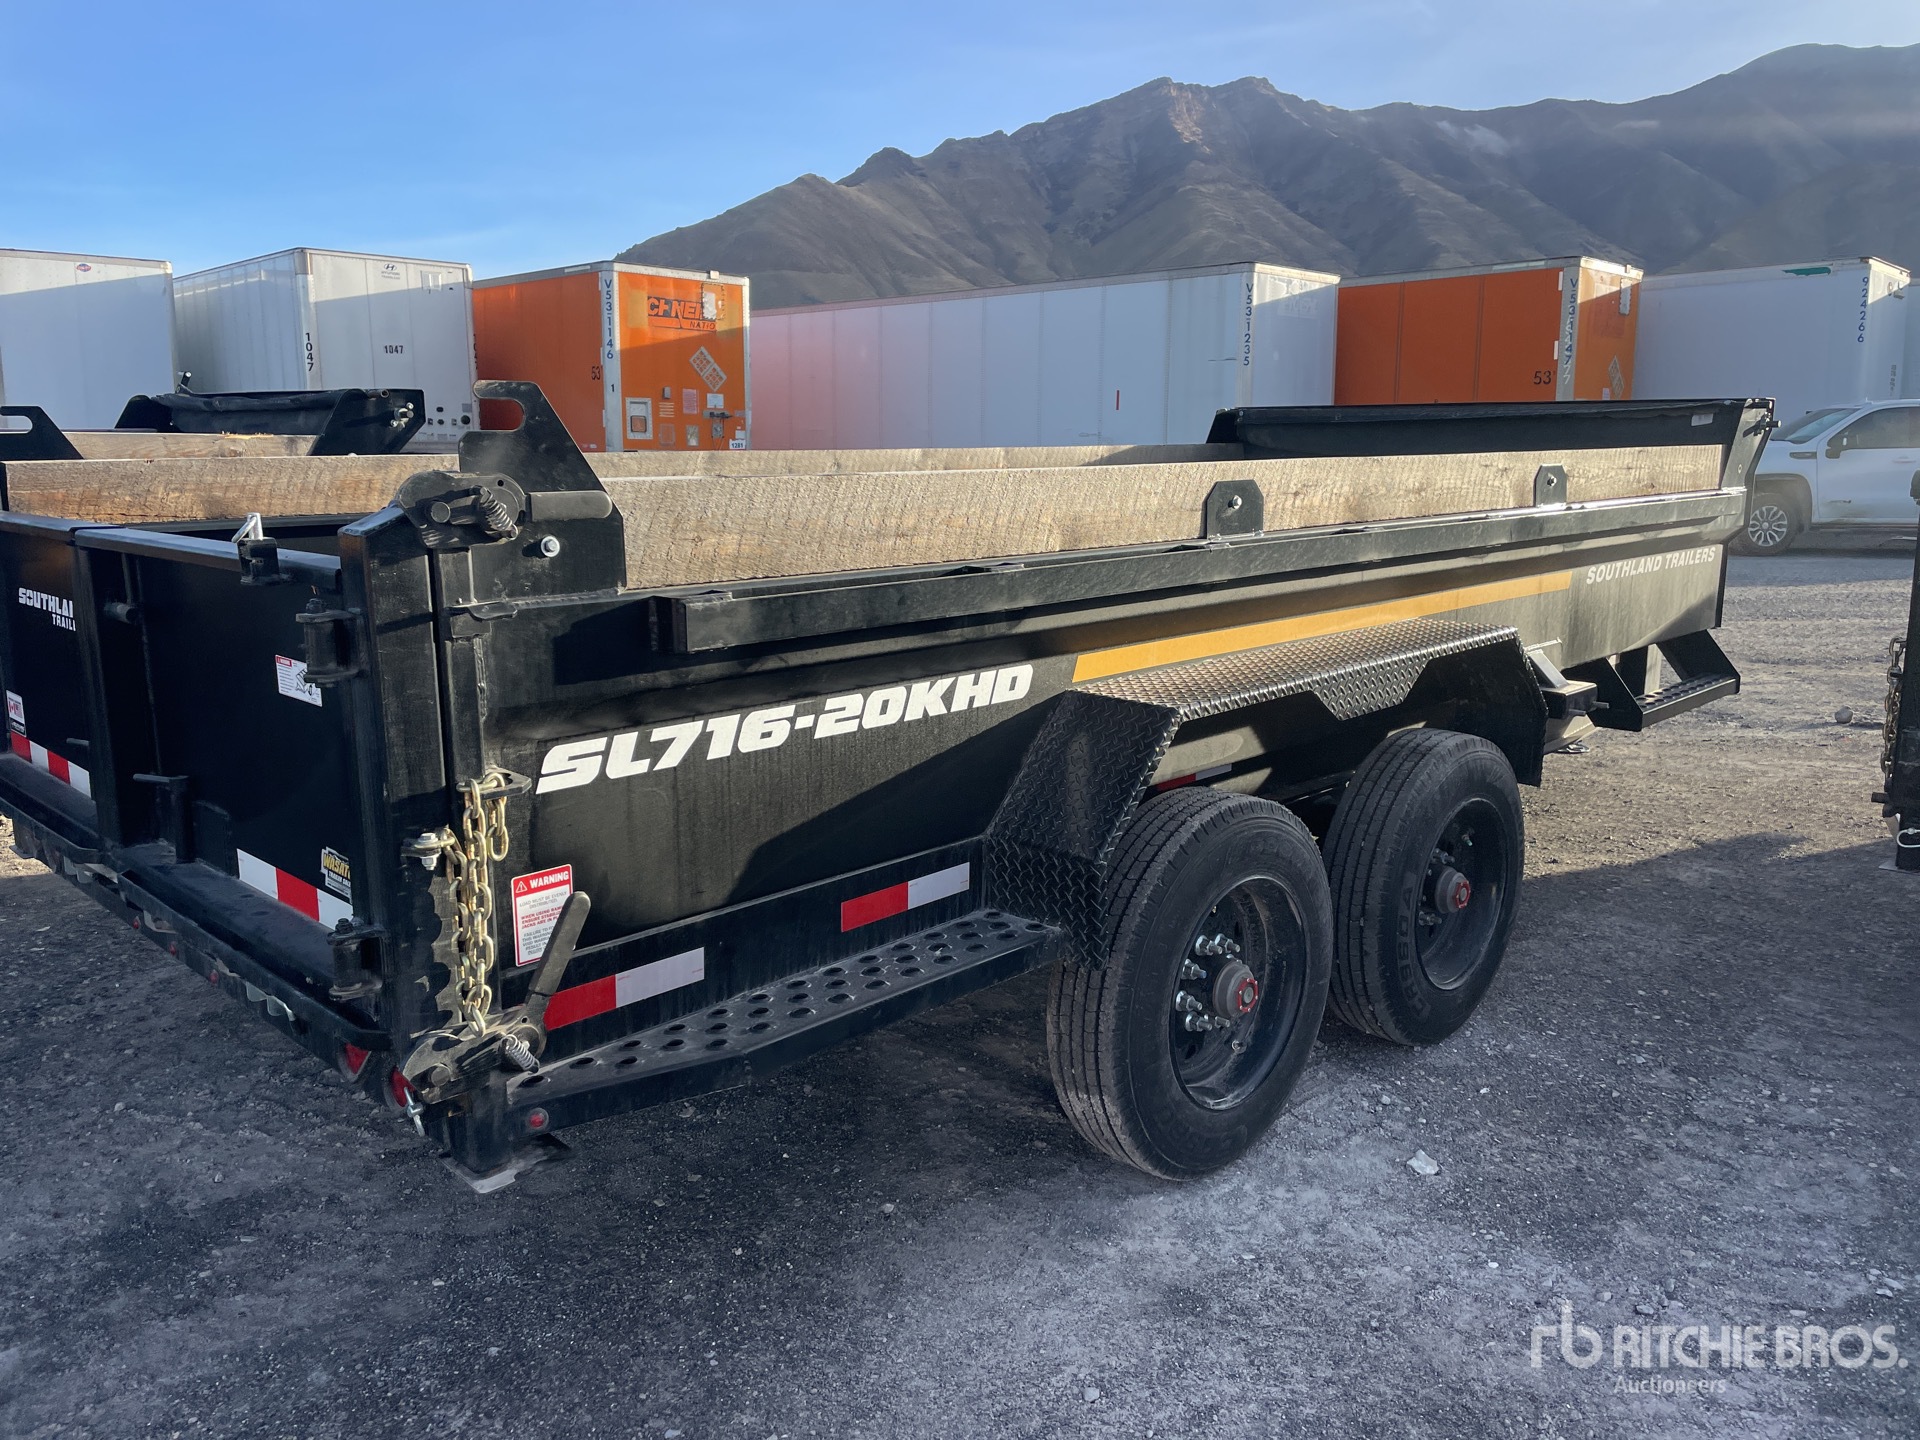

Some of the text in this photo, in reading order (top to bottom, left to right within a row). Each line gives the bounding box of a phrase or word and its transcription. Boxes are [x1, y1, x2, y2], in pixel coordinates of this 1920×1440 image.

[1857, 276, 1869, 343] 924266
[305, 332, 314, 372] 1047
[384, 345, 404, 354] 1047
[1586, 546, 1716, 585] SOUTHLAND TRAILERS
[535, 664, 1034, 795] SL716-20KHD
[530, 871, 569, 889] WARNING
